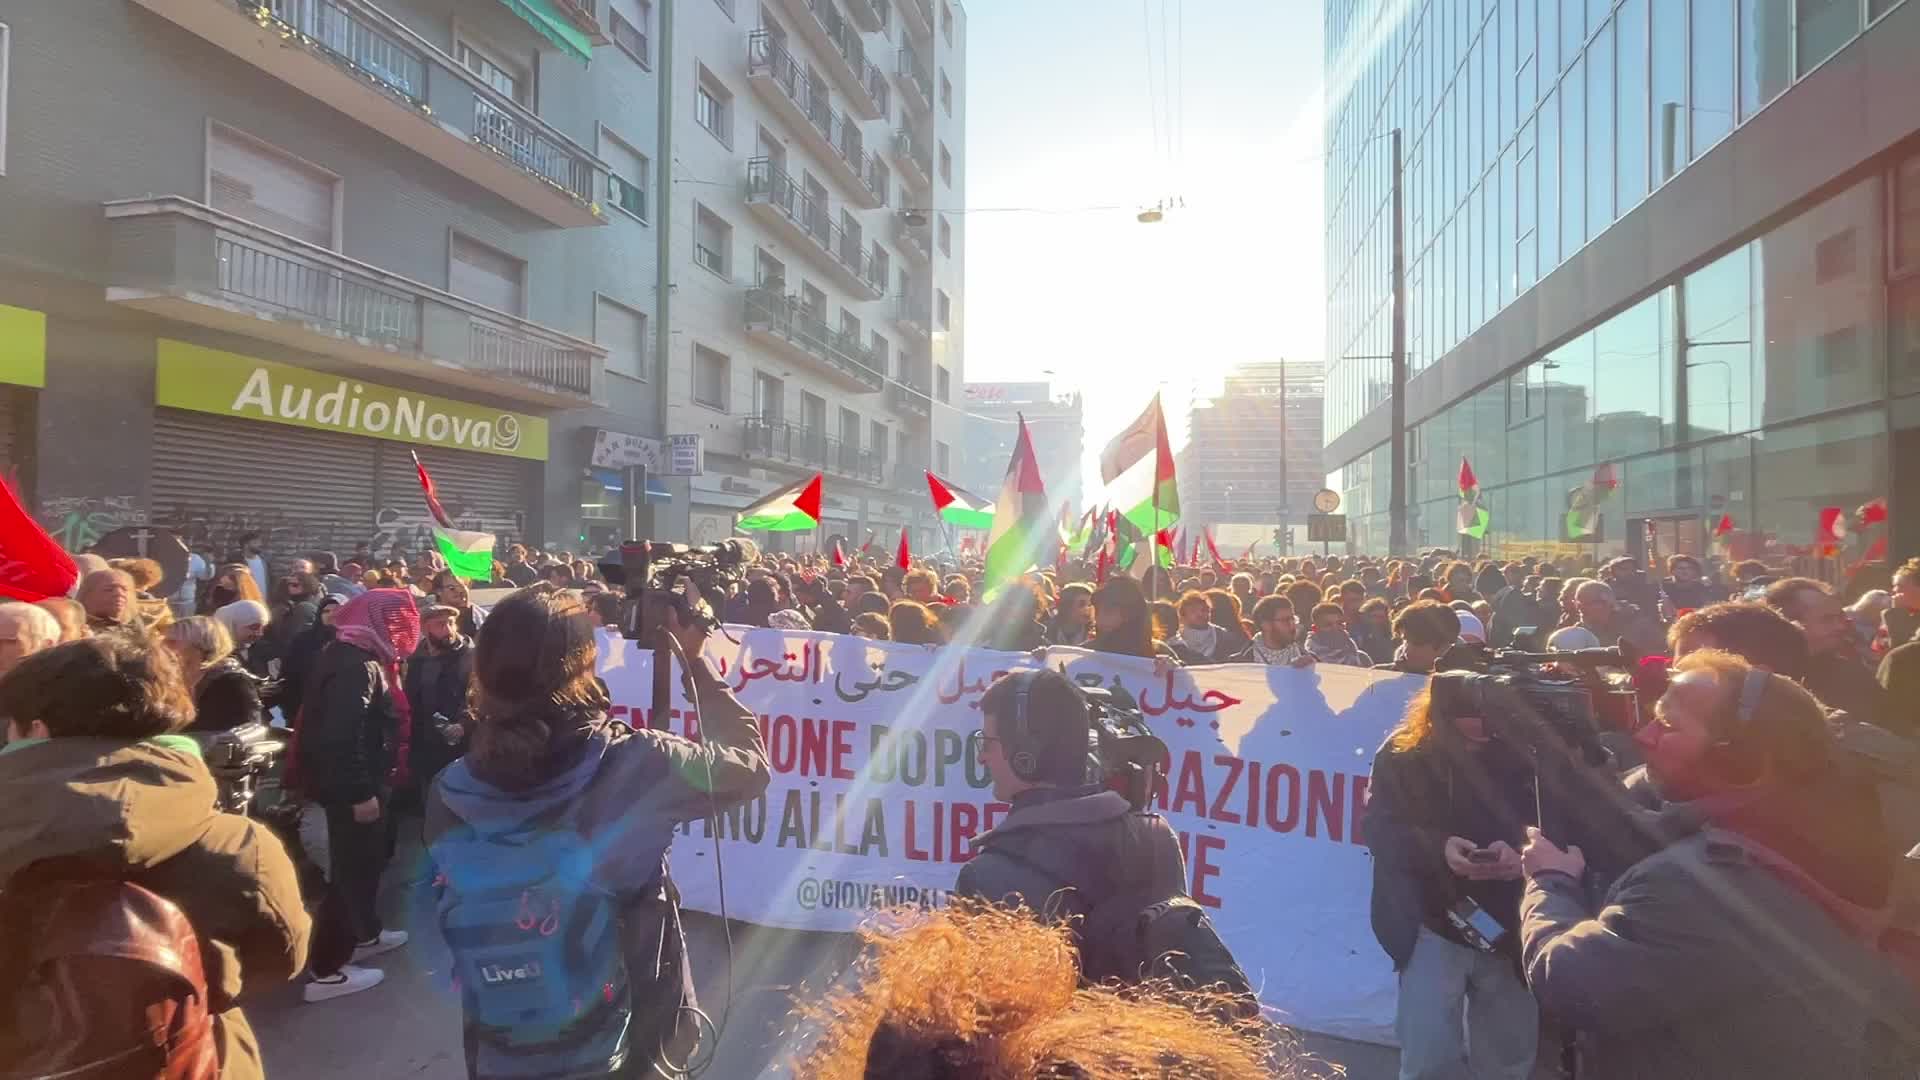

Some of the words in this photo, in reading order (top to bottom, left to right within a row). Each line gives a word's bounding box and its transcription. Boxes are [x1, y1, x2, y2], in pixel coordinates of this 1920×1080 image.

[232, 367, 492, 449] AudioNova
[673, 436, 697, 446] BAR
[835, 662, 920, 703] حتى
[1139, 669, 1241, 730] جيل
[870, 724, 993, 789] DOPO
[777, 789, 889, 858] ALLA
[482, 963, 541, 983] LiveU
